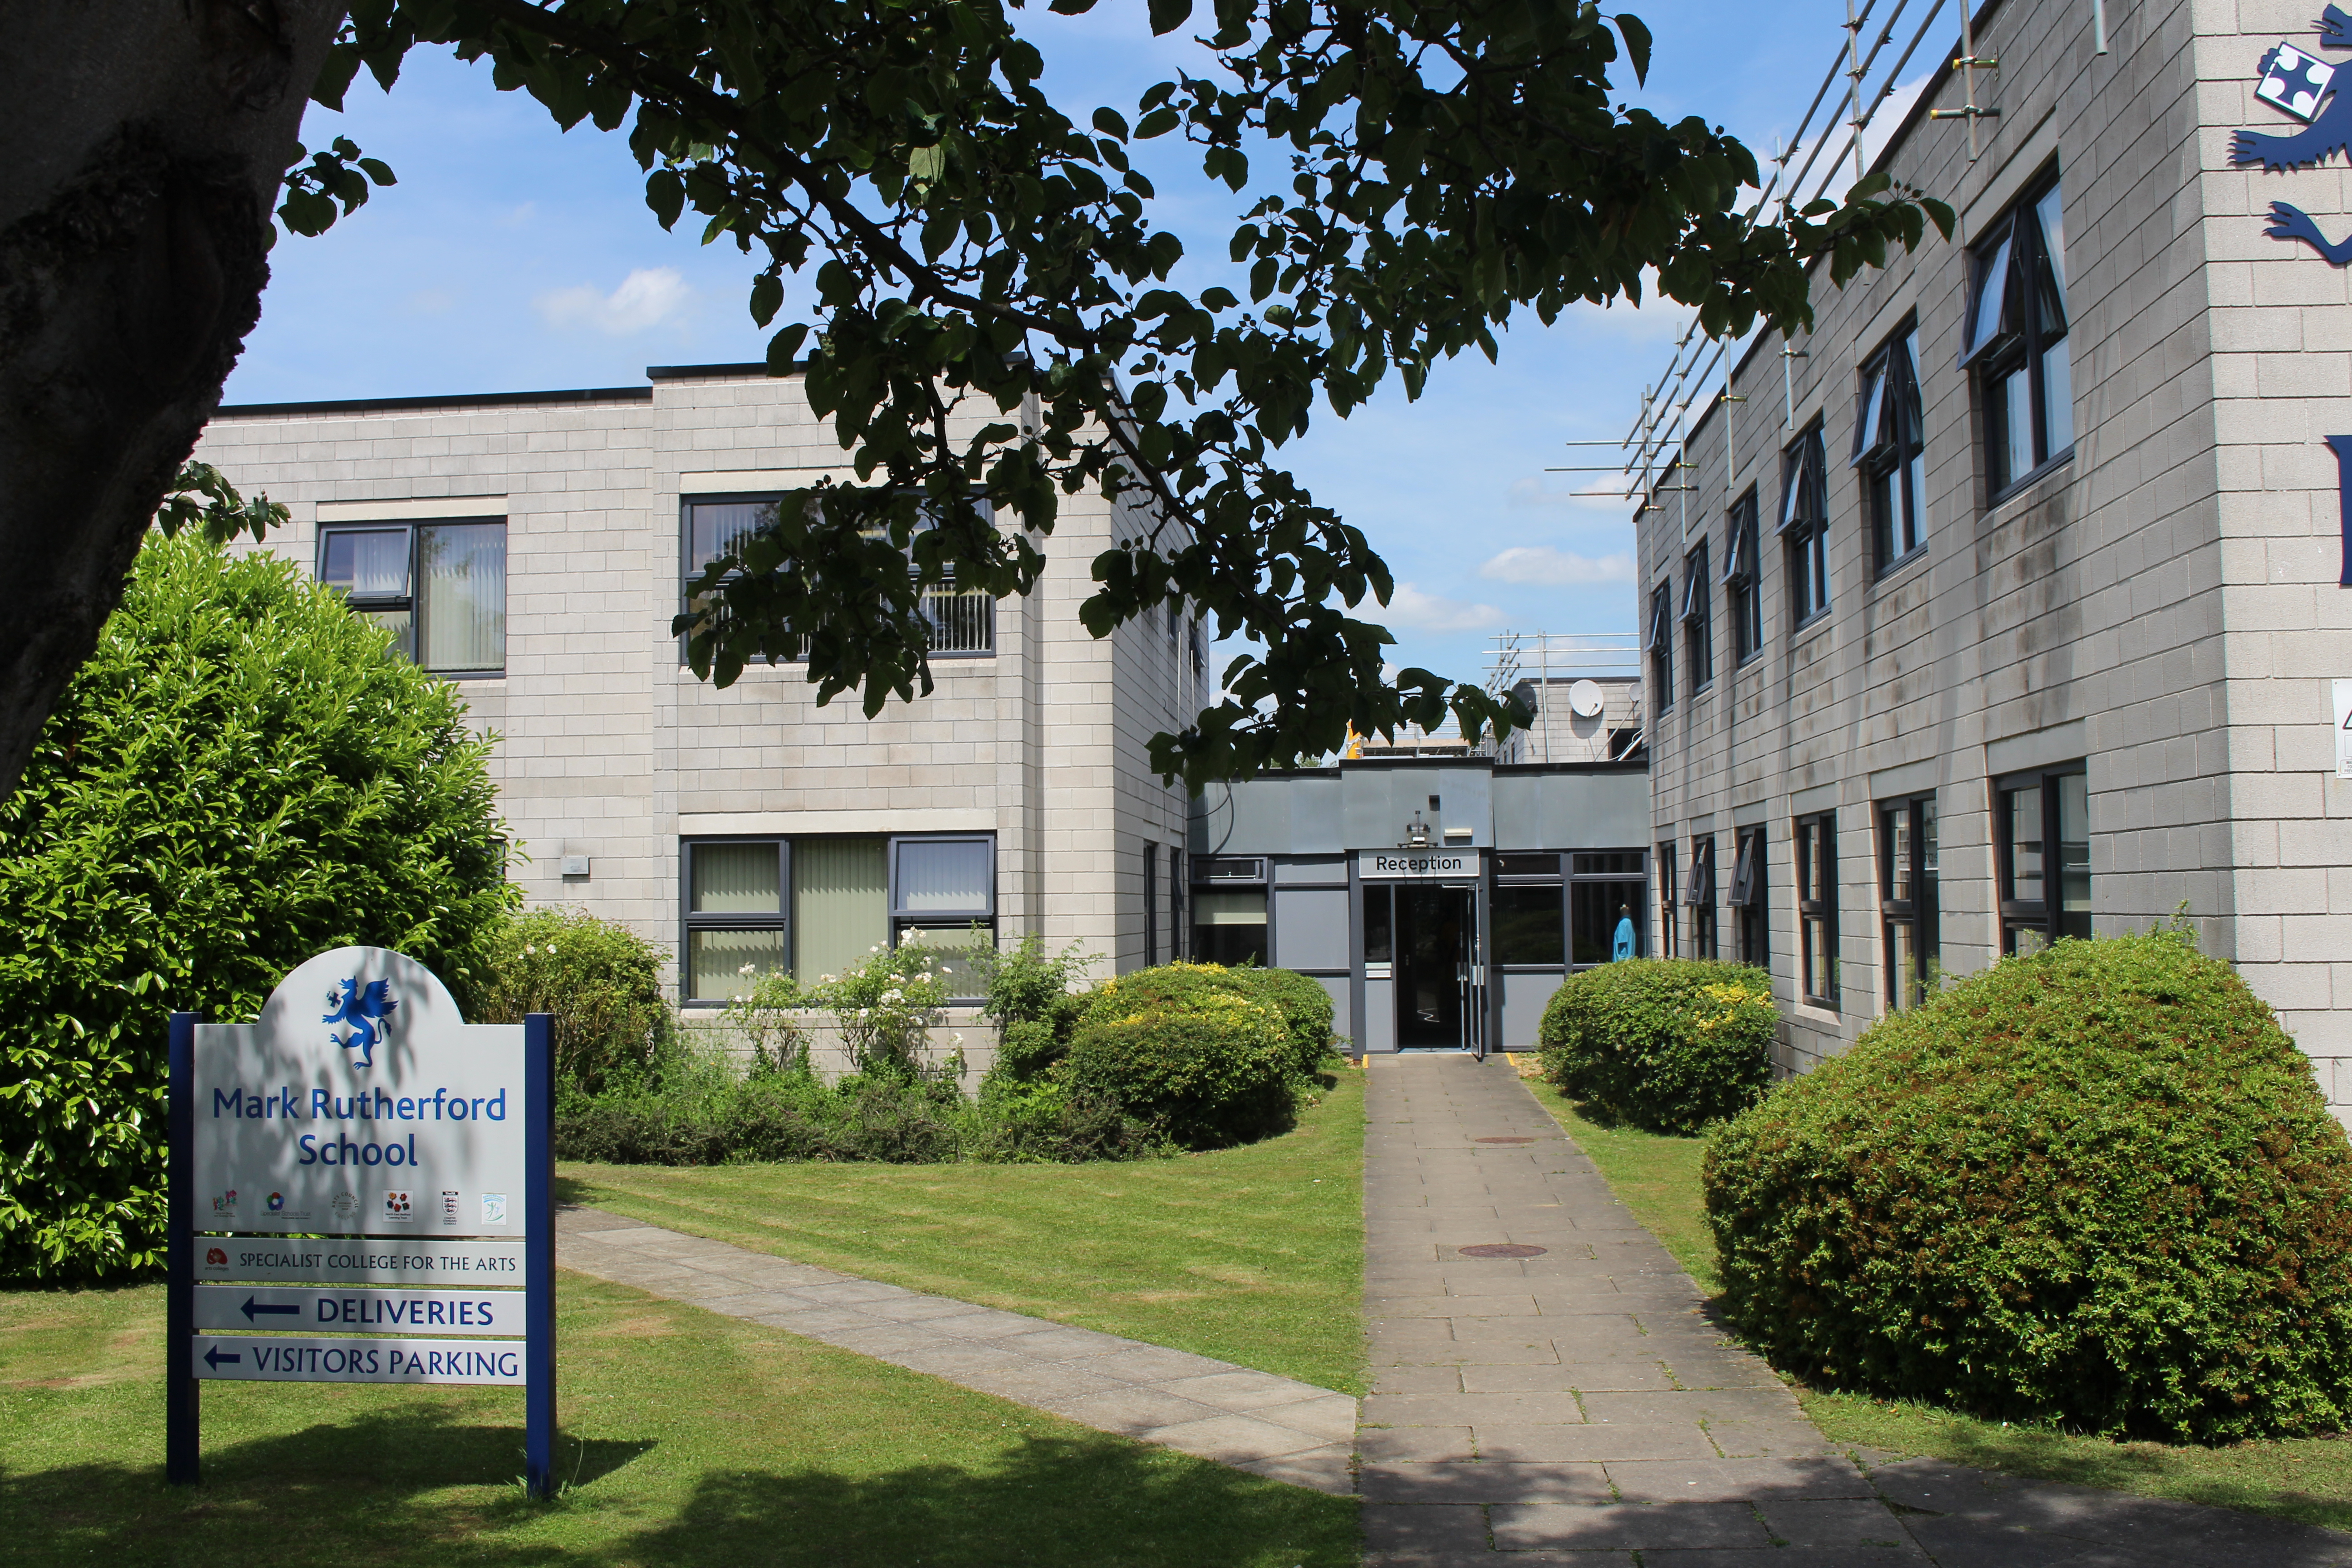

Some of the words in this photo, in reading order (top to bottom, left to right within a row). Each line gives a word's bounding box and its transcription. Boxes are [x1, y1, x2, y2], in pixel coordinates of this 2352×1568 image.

[1377, 856, 1461, 872] Reception
[213, 1086, 300, 1119] Mark
[312, 1087, 506, 1121] Rutherford
[299, 1133, 418, 1166] School
[332, 1194, 340, 1208] ARTS
[341, 1192, 358, 1208] COUNCIL
[240, 1253, 323, 1268] SPECIALIST
[328, 1254, 398, 1269] COLLEGE
[403, 1256, 434, 1270] FOR
[440, 1256, 470, 1270] THE
[475, 1257, 515, 1271] ARTS
[318, 1298, 493, 1326] DELIVERIES
[252, 1347, 379, 1374] VISITORS
[389, 1350, 518, 1377] PARKING
